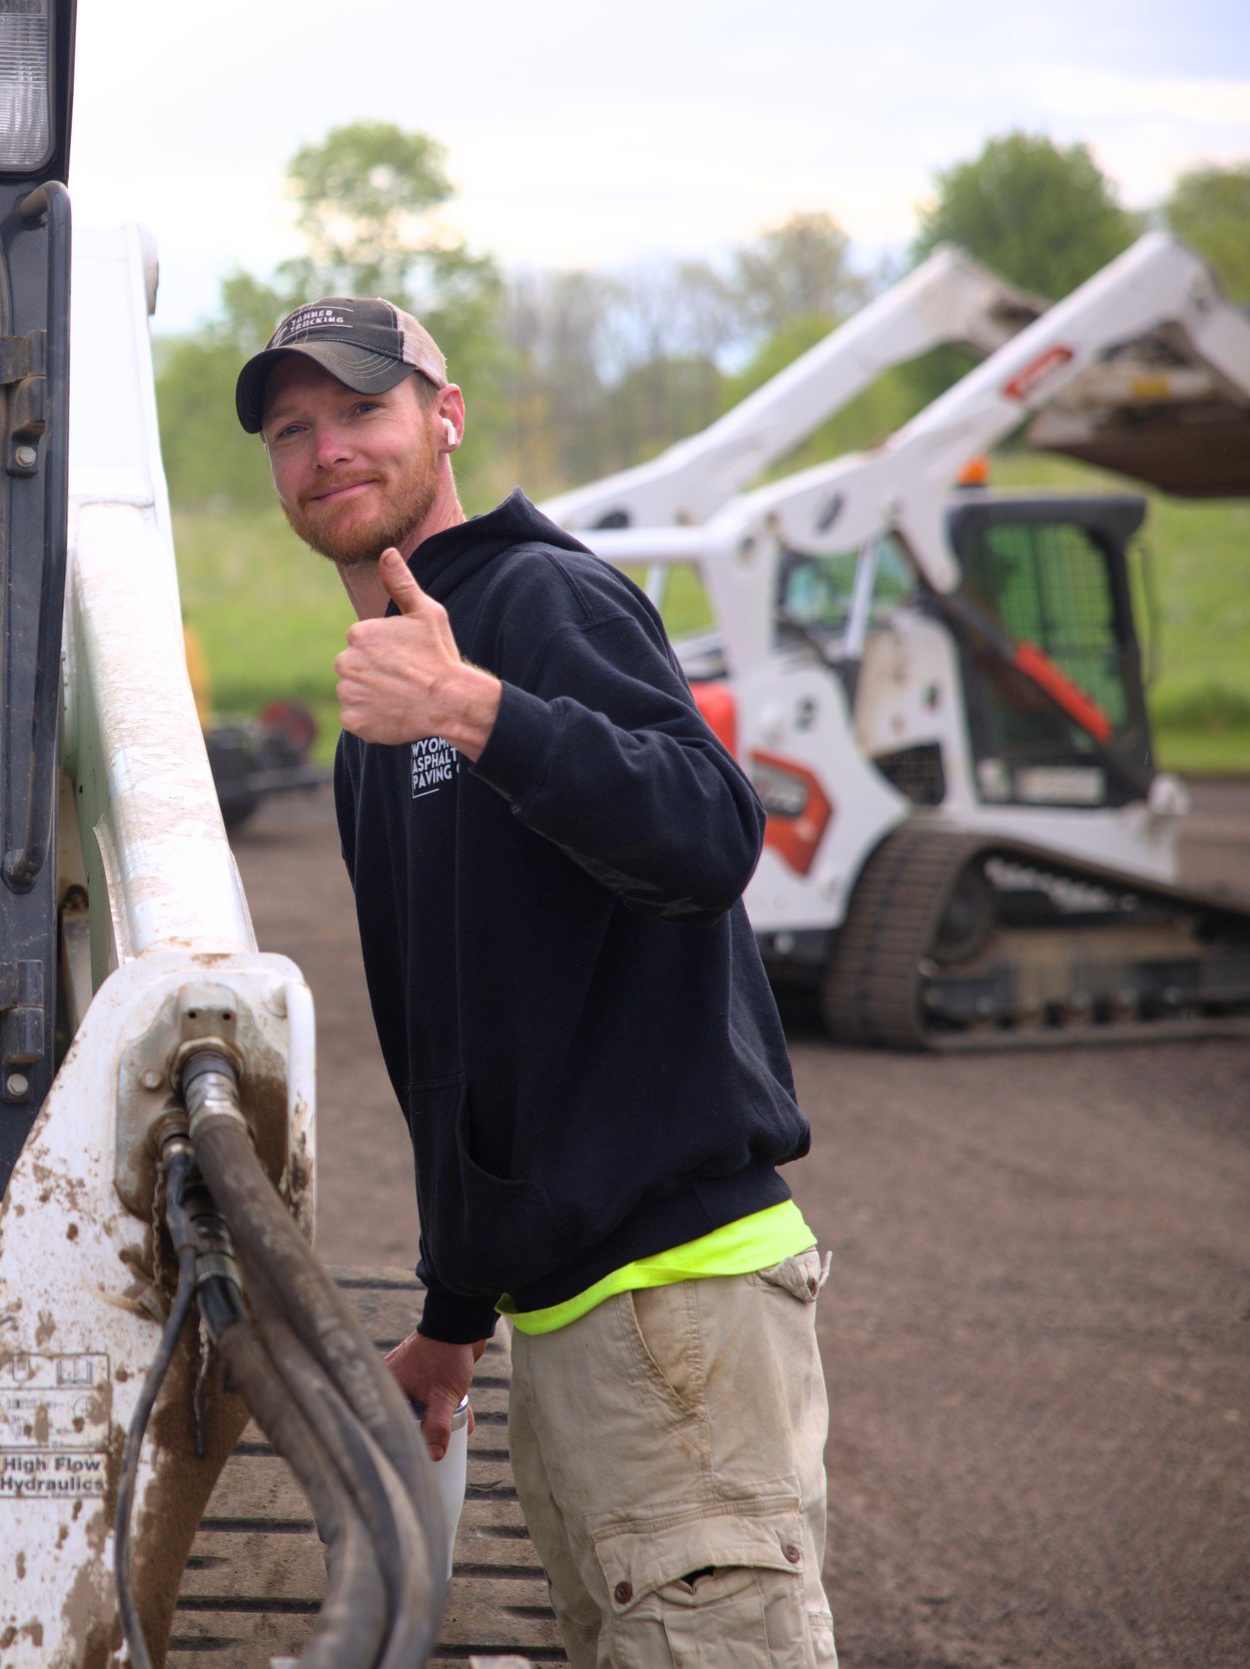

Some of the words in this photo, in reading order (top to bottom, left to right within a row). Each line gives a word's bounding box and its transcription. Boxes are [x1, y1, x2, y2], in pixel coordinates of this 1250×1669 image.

[290, 317, 344, 333] TRUCKING
[291, 309, 333, 327] TANNER
[411, 736, 451, 758] WYOM
[412, 747, 458, 775] ASPHALT
[412, 764, 453, 790] PAVING
[5, 1457, 47, 1473] High
[54, 1457, 101, 1471] Flow
[0, 1477, 105, 1491] Hydraulics
